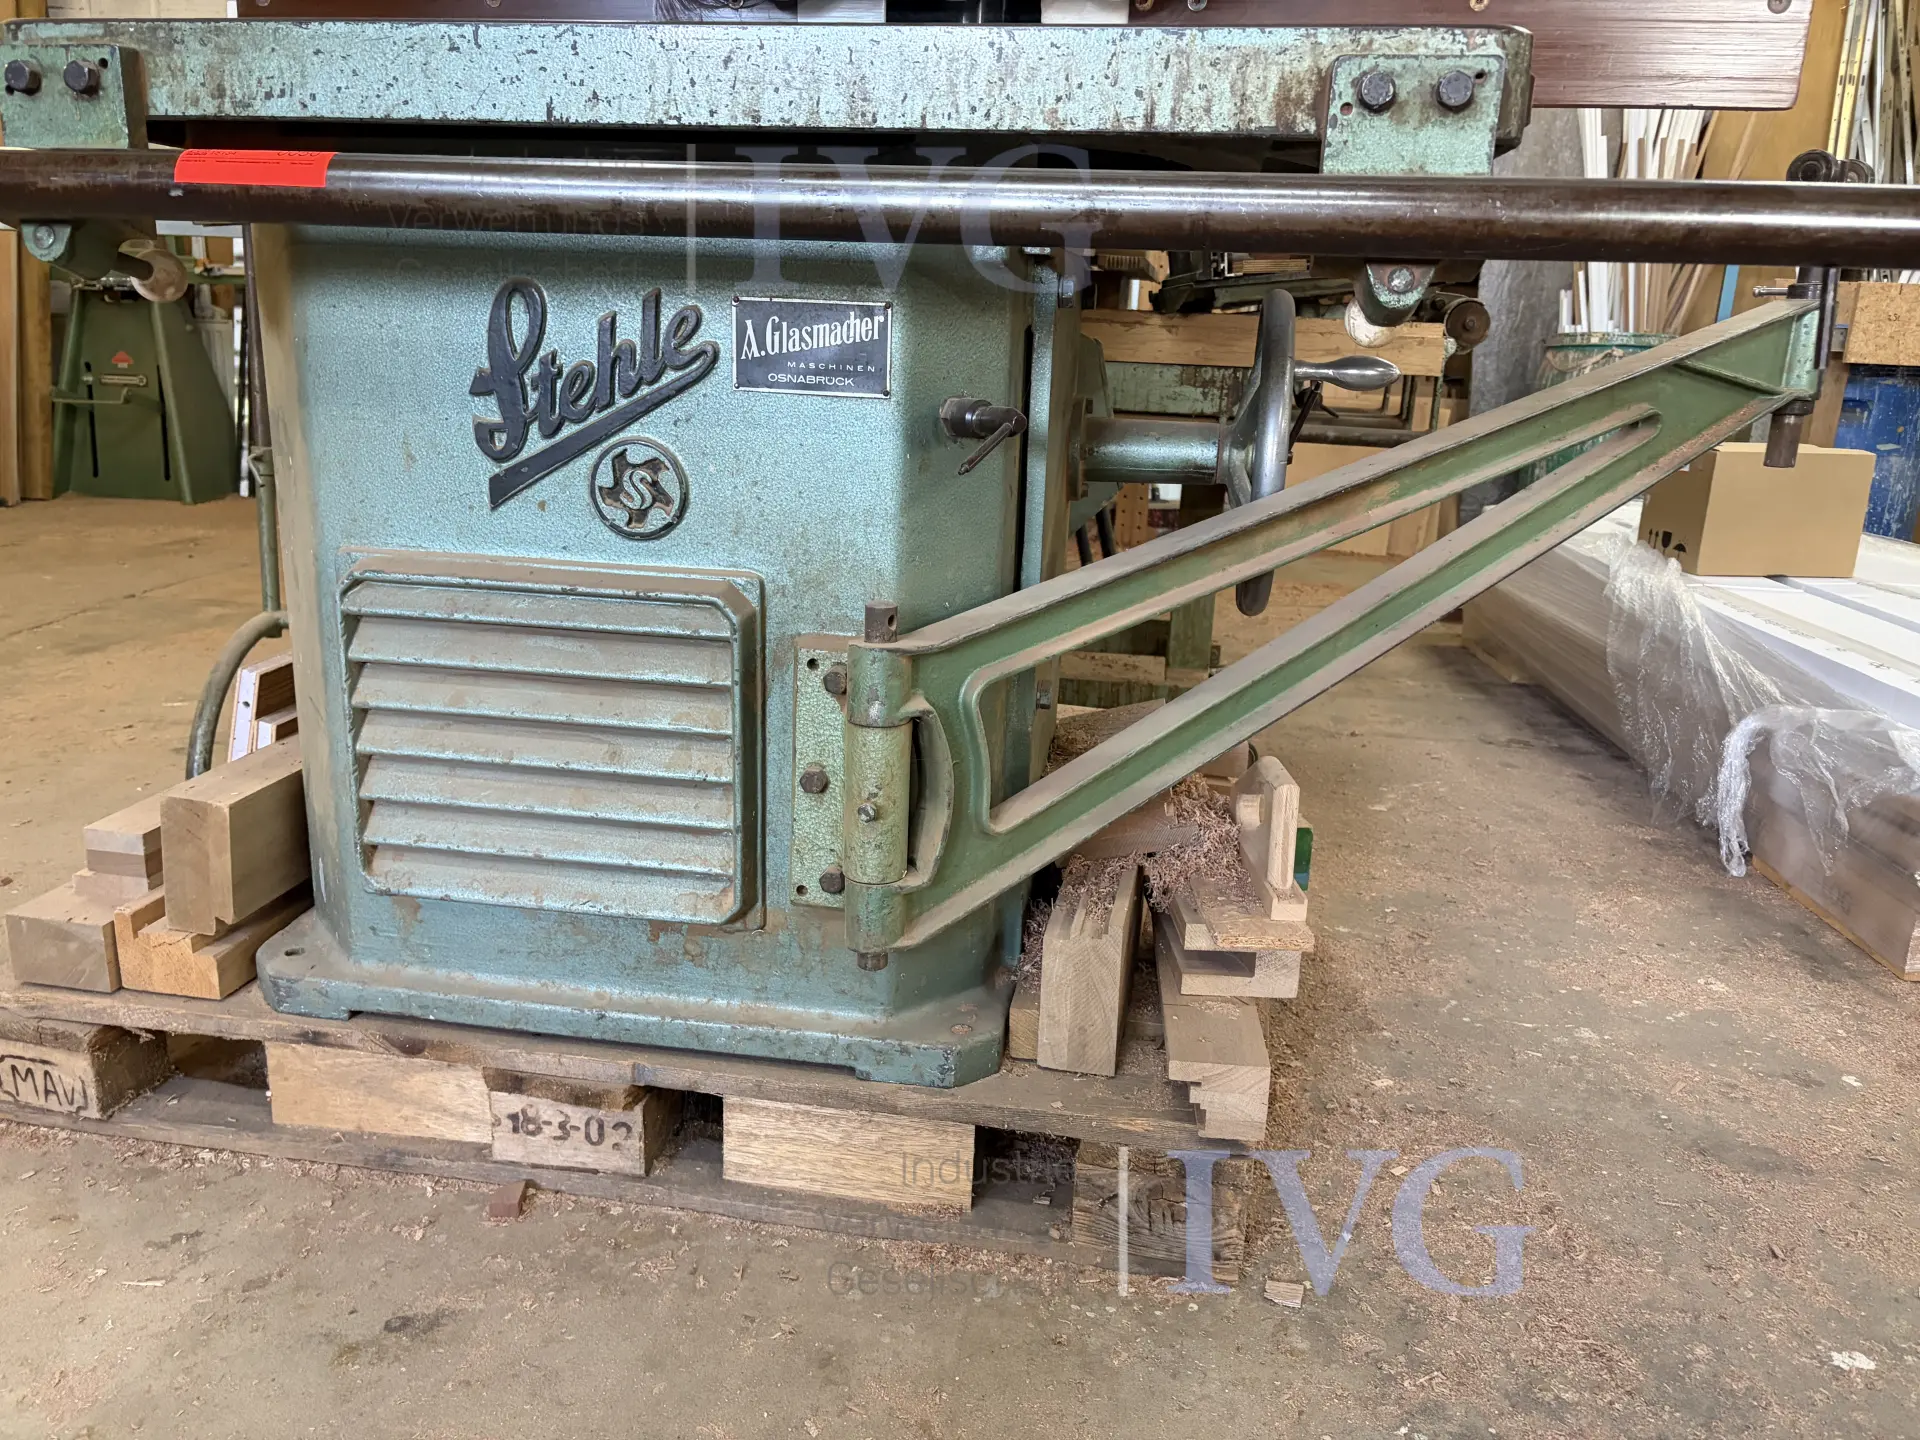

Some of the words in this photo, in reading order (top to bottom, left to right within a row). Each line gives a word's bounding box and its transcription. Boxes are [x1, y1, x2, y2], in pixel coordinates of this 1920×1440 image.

[470, 276, 719, 462] Stehle
[787, 361, 875, 372] MASCHINEN
[767, 372, 855, 387] OSNABRÜCK
